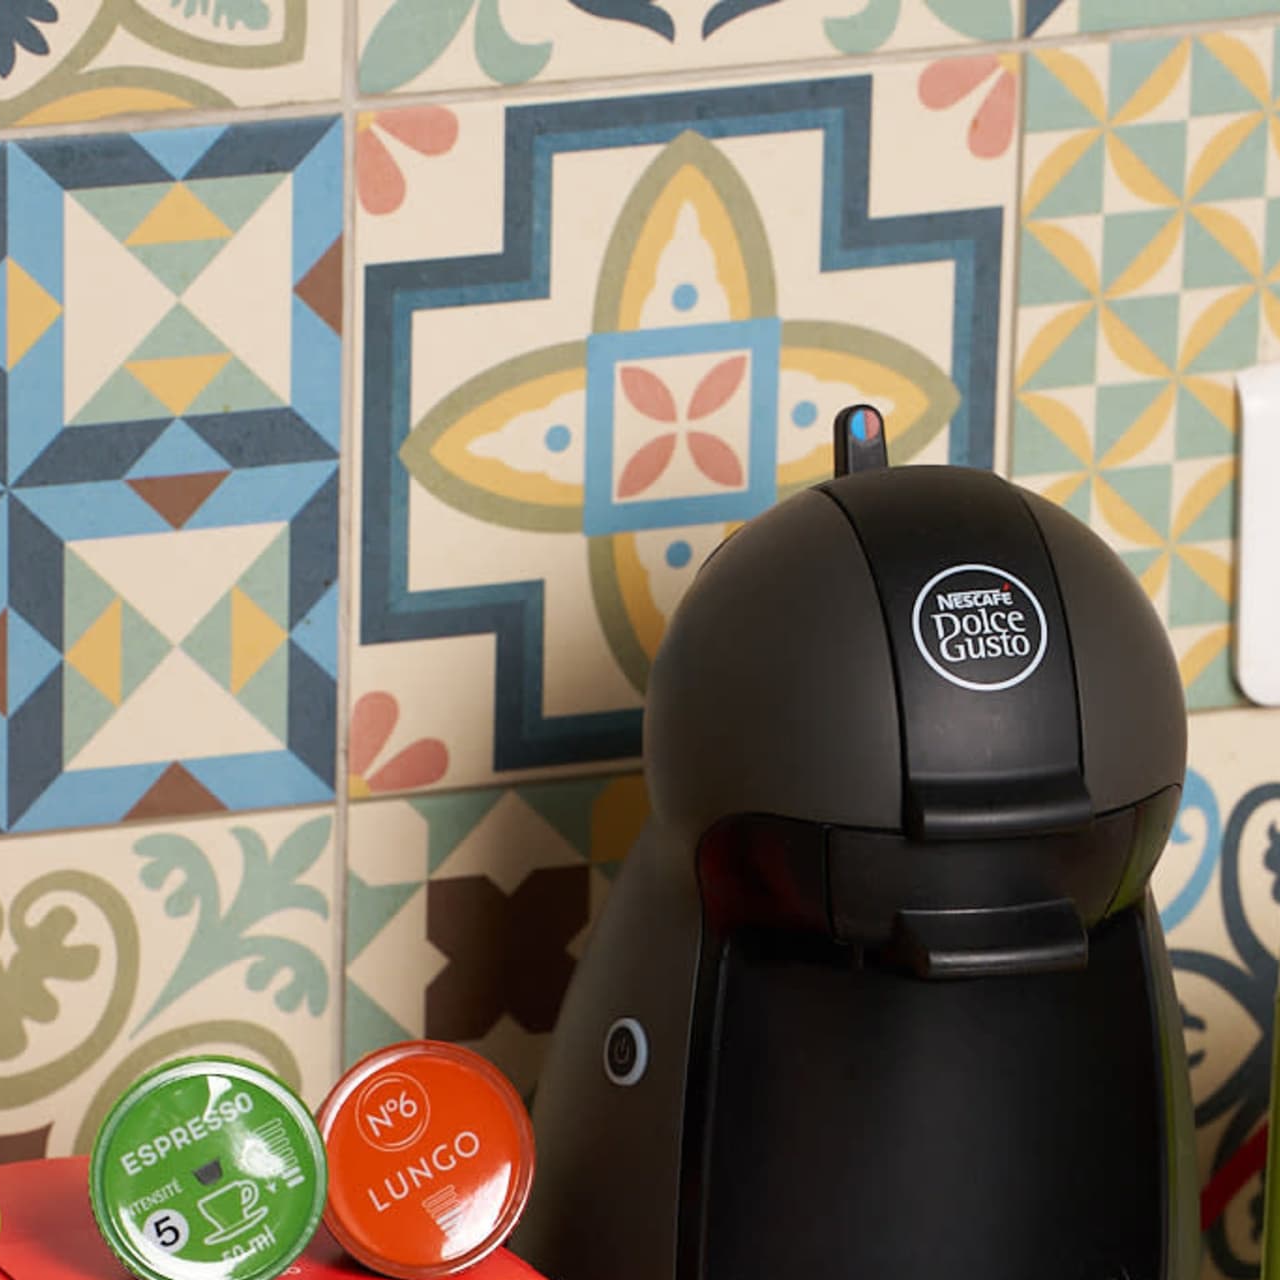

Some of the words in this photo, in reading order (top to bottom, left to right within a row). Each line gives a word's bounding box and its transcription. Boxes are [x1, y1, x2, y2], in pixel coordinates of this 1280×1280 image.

[936, 582, 1013, 611] NESCAFÉ
[931, 608, 1026, 639] Dolce
[939, 631, 1031, 663] Gusto
[120, 1091, 254, 1176] ESPRESSO
[368, 1130, 480, 1213] LUNGO
[153, 1215, 180, 1248] 5
